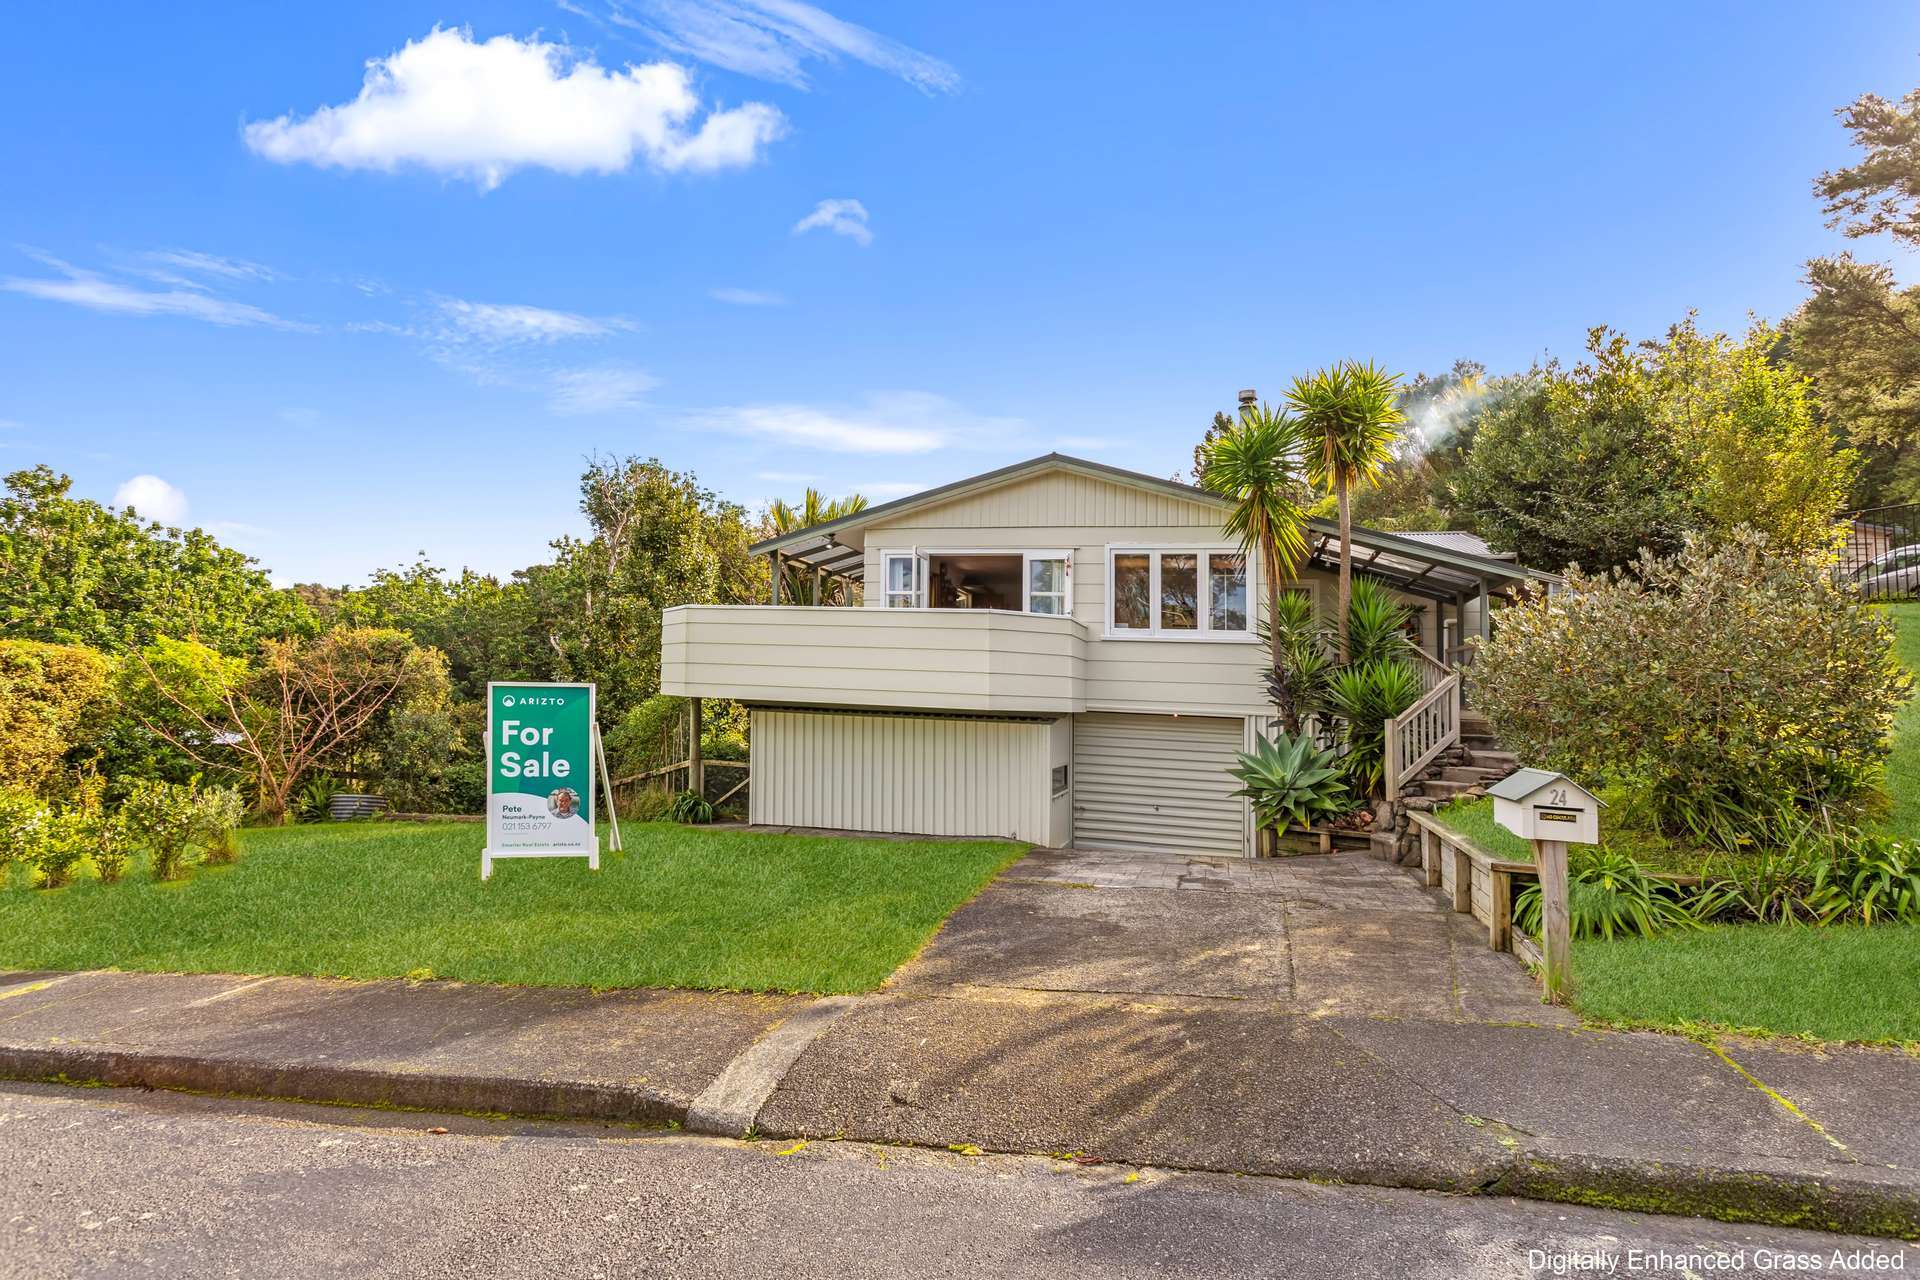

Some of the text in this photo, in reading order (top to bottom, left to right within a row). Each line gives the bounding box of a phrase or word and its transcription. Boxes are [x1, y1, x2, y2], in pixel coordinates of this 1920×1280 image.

[519, 697, 565, 706] ARIZTO
[502, 720, 554, 746] For
[500, 751, 570, 778] Sale
[1550, 789, 1567, 806] 24
[502, 805, 522, 813] Pete
[502, 822, 552, 831] 021 153 6797
